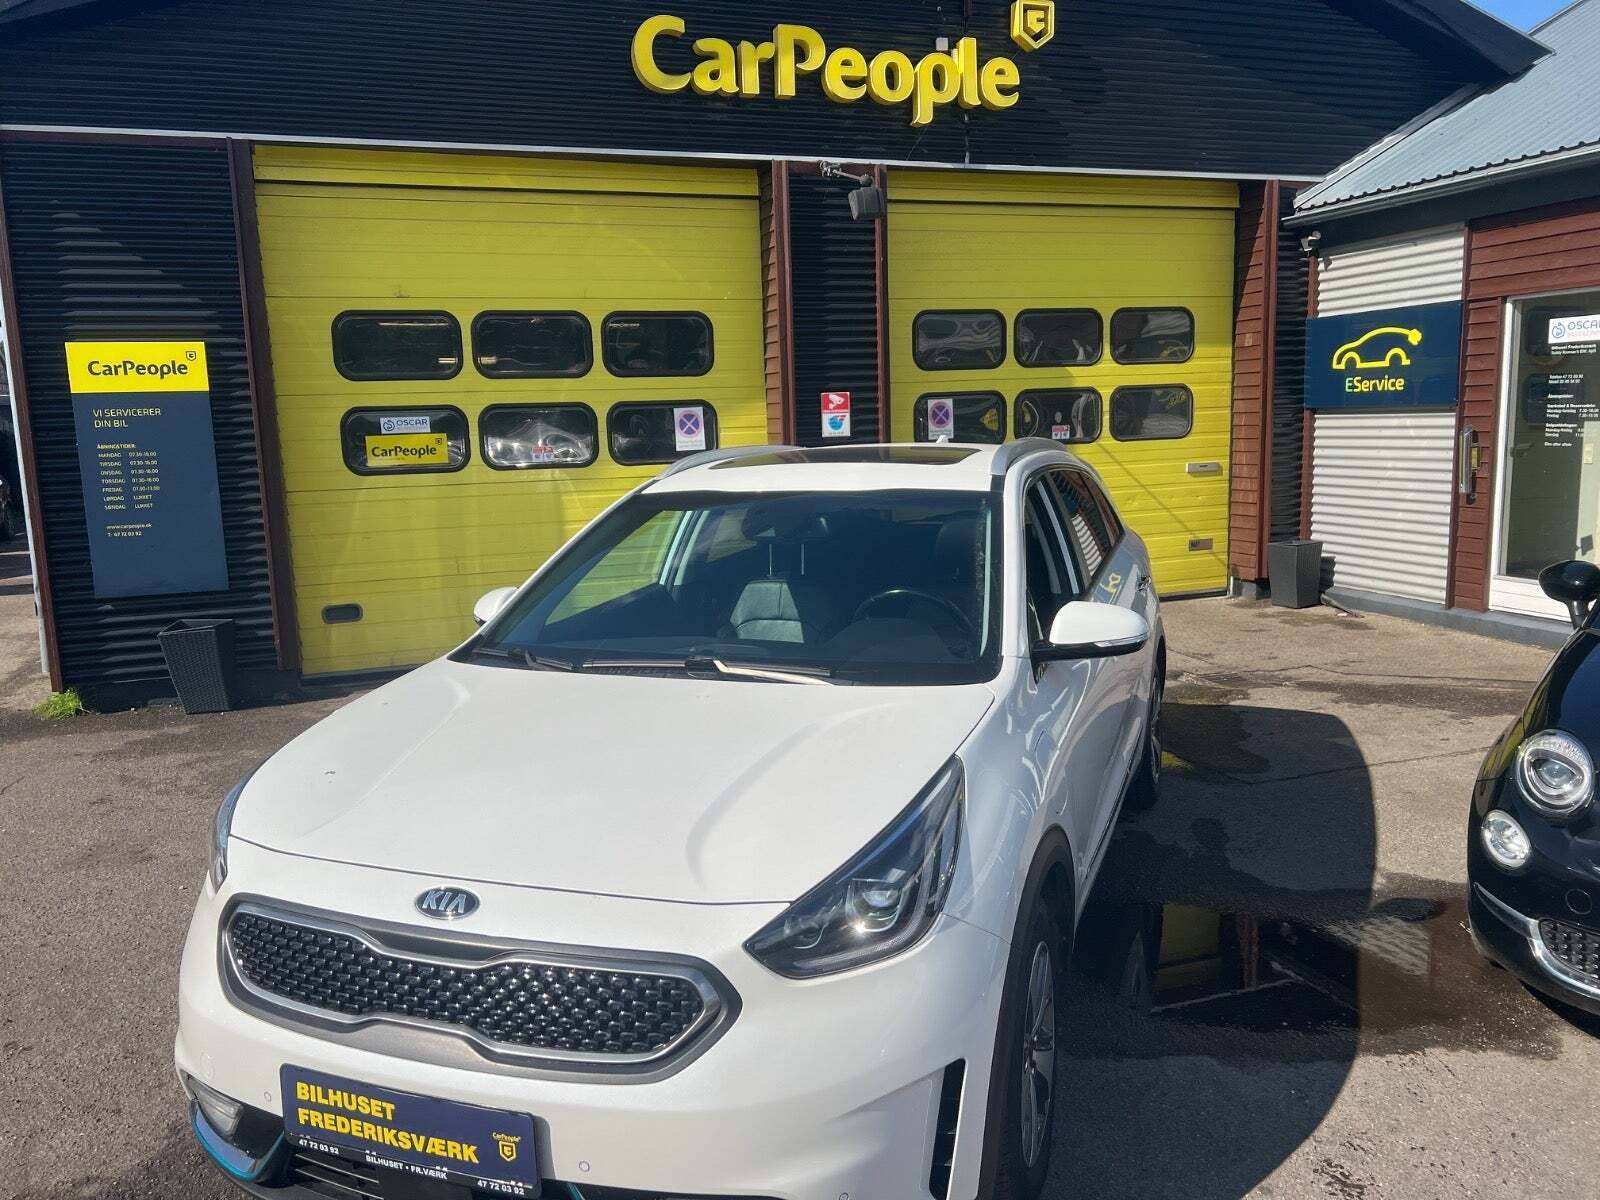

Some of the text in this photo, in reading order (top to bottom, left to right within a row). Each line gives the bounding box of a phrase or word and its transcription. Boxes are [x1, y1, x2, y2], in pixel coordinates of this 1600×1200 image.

[631, 14, 1021, 127] CarPeople
[1567, 319, 1600, 331] OSCA
[87, 360, 188, 380] CarPeople
[1345, 374, 1405, 393] EService
[92, 407, 162, 418] VI SERVICERER
[94, 419, 129, 429] DIN BIL
[396, 418, 428, 427] OSCAR
[371, 445, 438, 459] CarPeople
[422, 890, 467, 914] KIA
[296, 1081, 396, 1121] BILHUSET
[297, 1107, 480, 1164] FREDERIKSVÆRK
[298, 1139, 308, 1147] 47
[309, 1141, 319, 1150] 72
[365, 1154, 404, 1170] BILHUSET
[477, 1179, 525, 1196] 47 72 03 92
